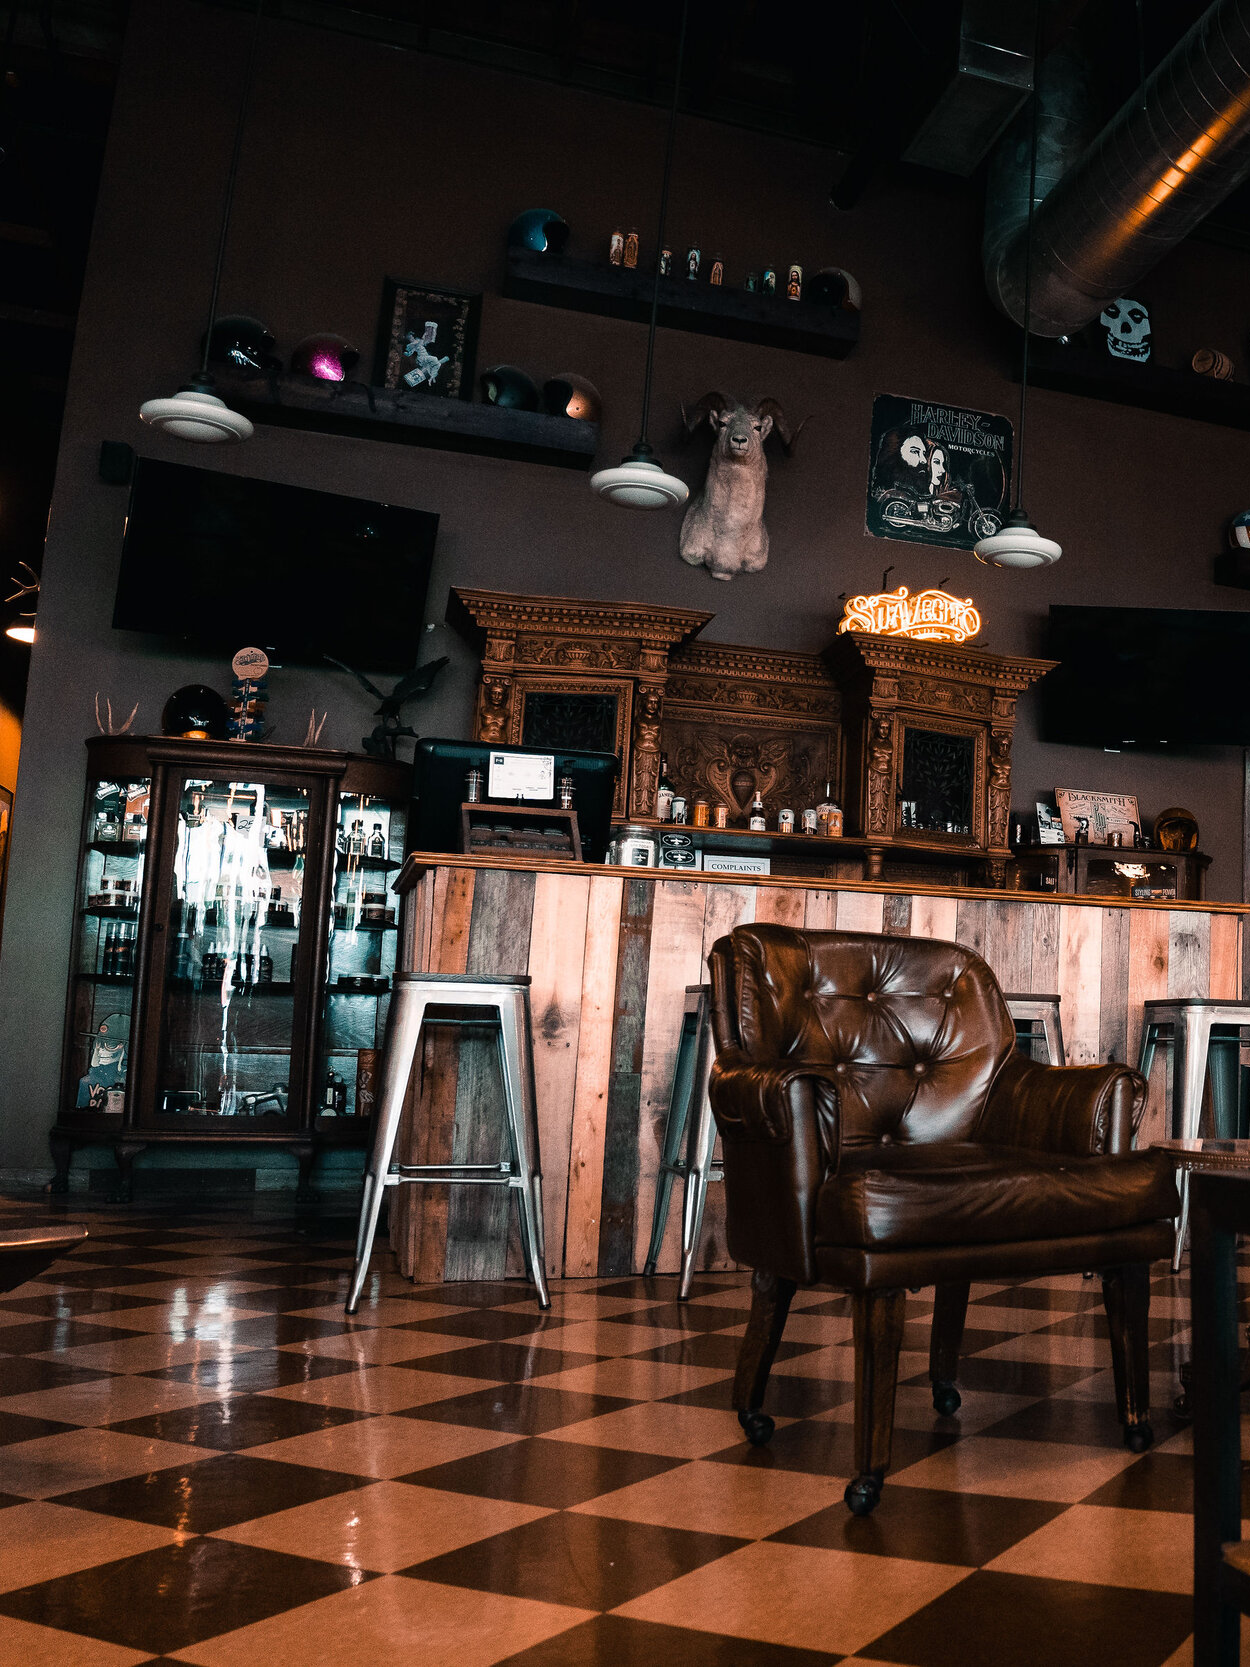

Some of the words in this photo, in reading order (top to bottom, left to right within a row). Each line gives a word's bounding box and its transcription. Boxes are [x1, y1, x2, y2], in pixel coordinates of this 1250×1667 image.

[927, 423, 1005, 451] DAVIDSON
[947, 444, 996, 457] MOTORCYCLES
[1068, 792, 1126, 807] BLACKSMITH
[711, 862, 762, 873] COMPLAINTS
